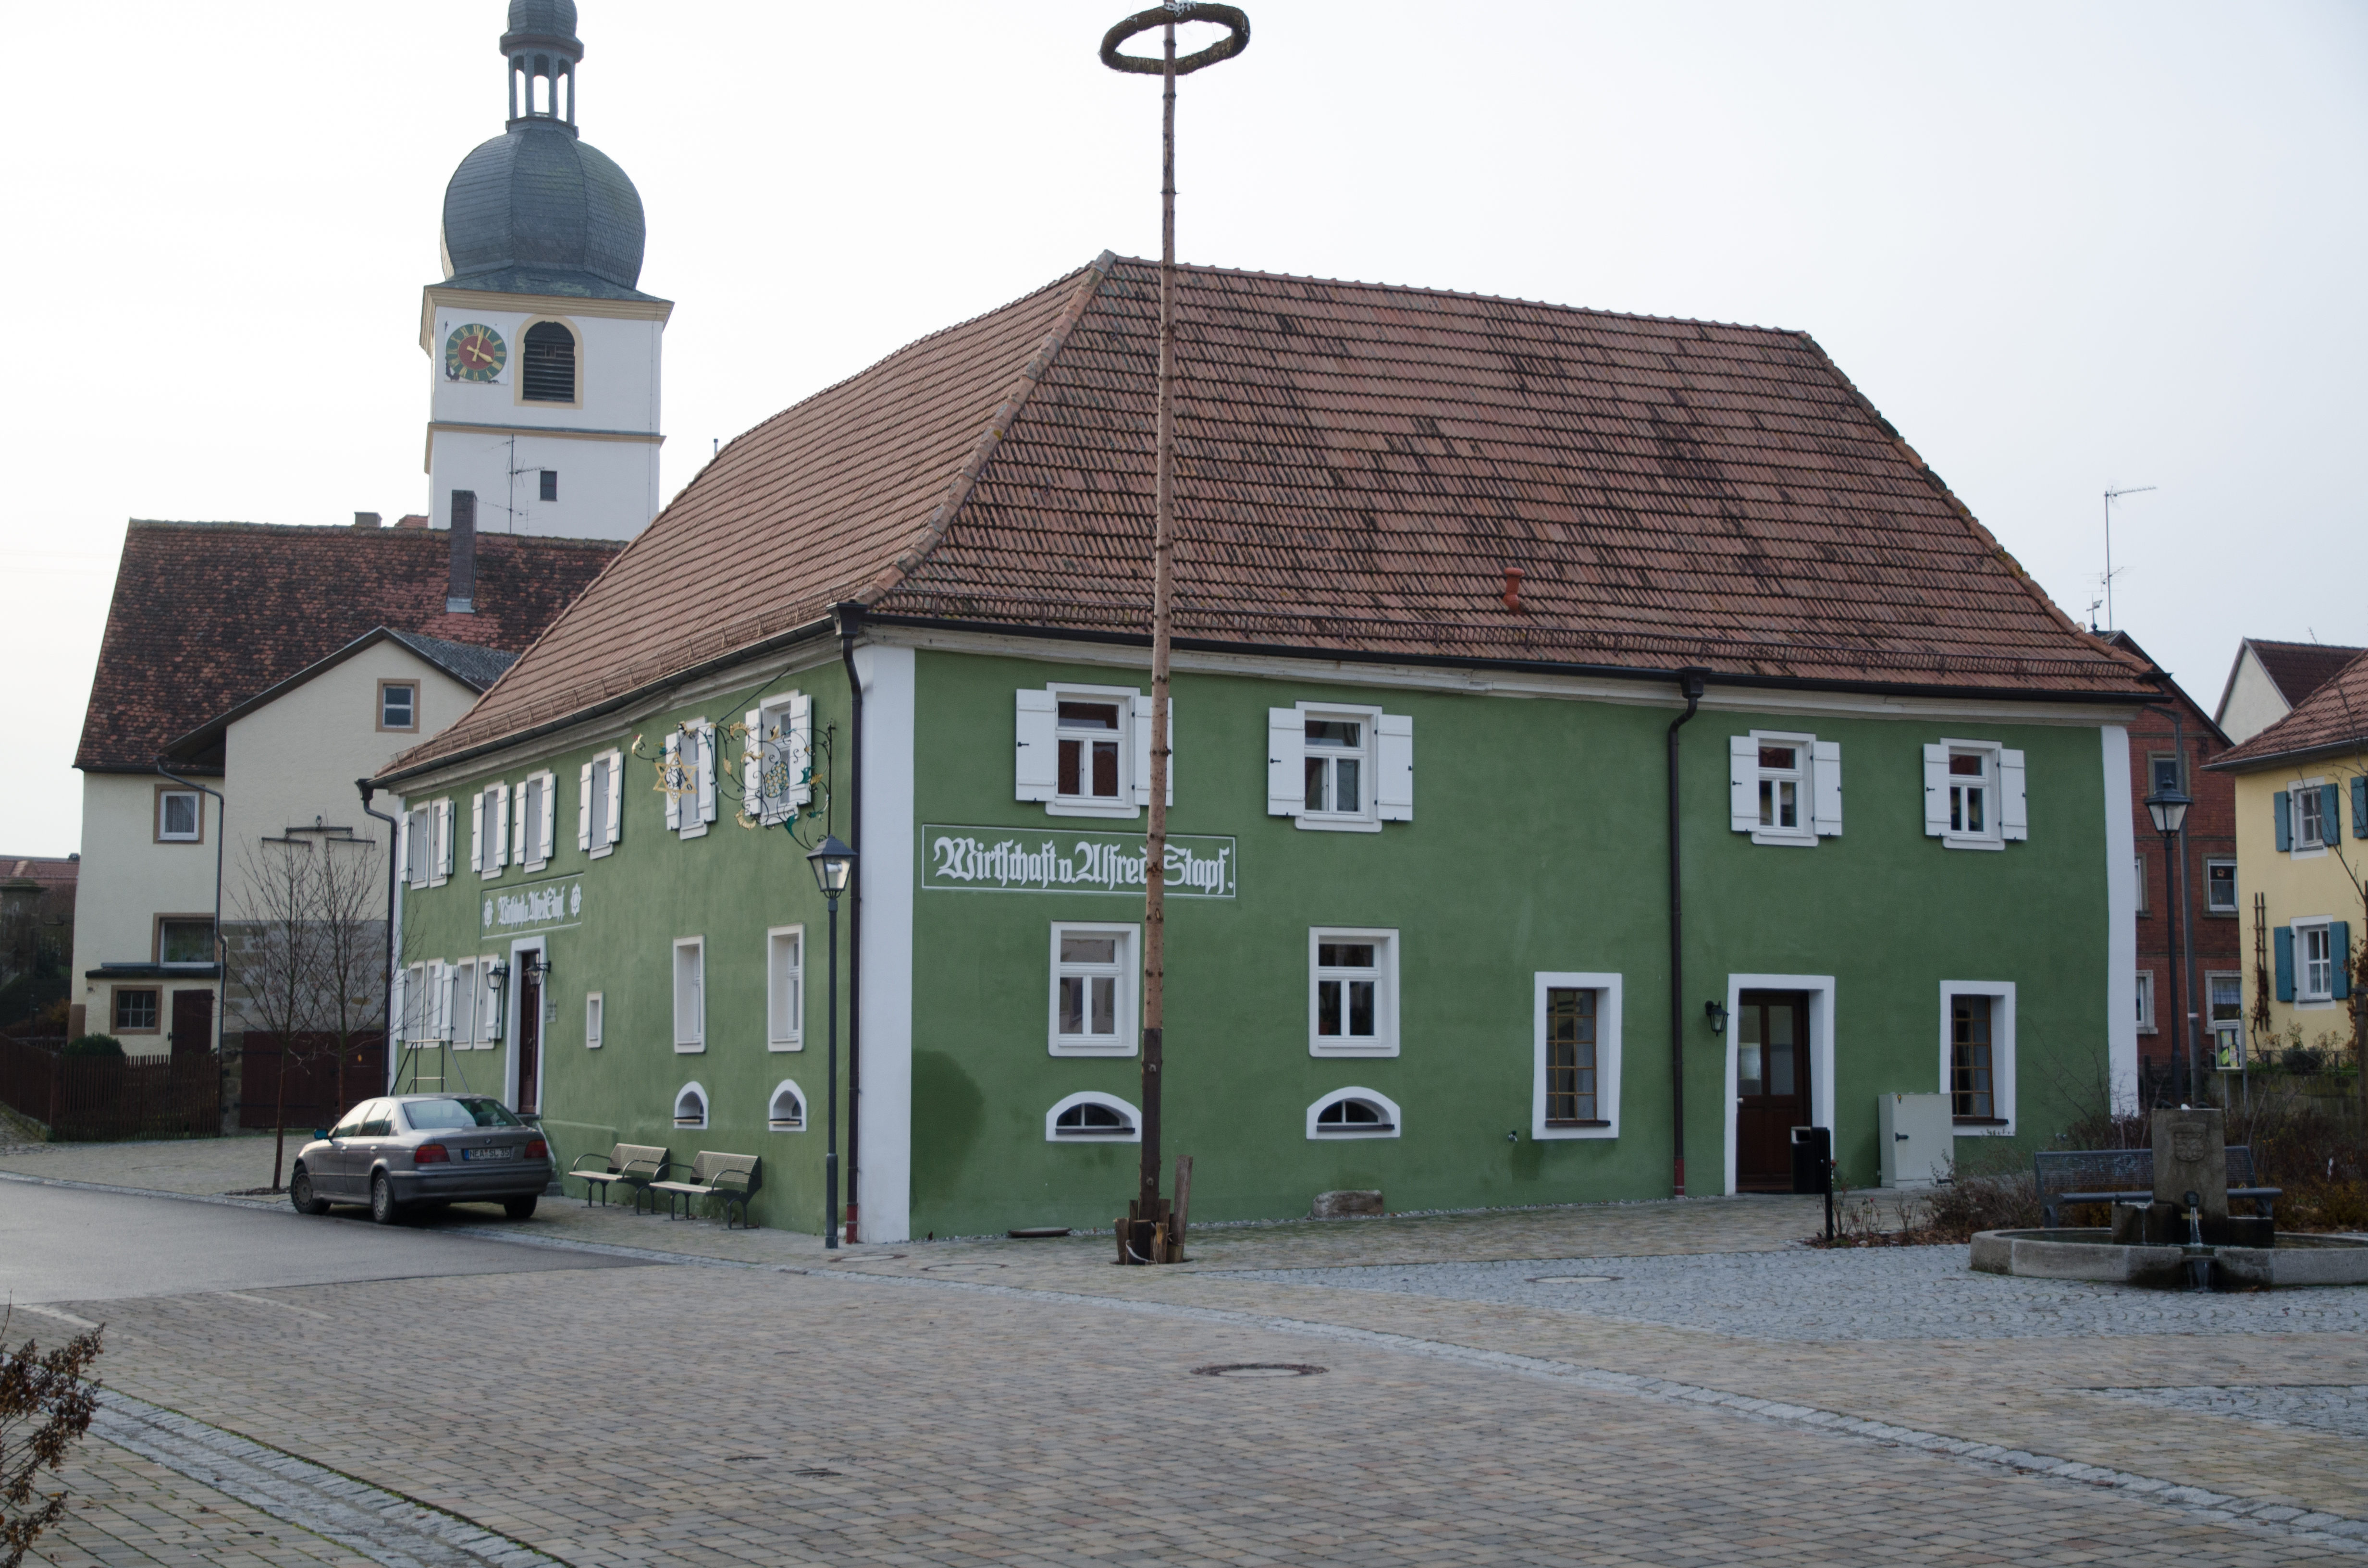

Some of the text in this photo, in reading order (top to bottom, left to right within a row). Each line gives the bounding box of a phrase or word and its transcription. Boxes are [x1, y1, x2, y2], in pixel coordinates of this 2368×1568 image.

[469, 1149, 510, 1158] NEA SL 35
